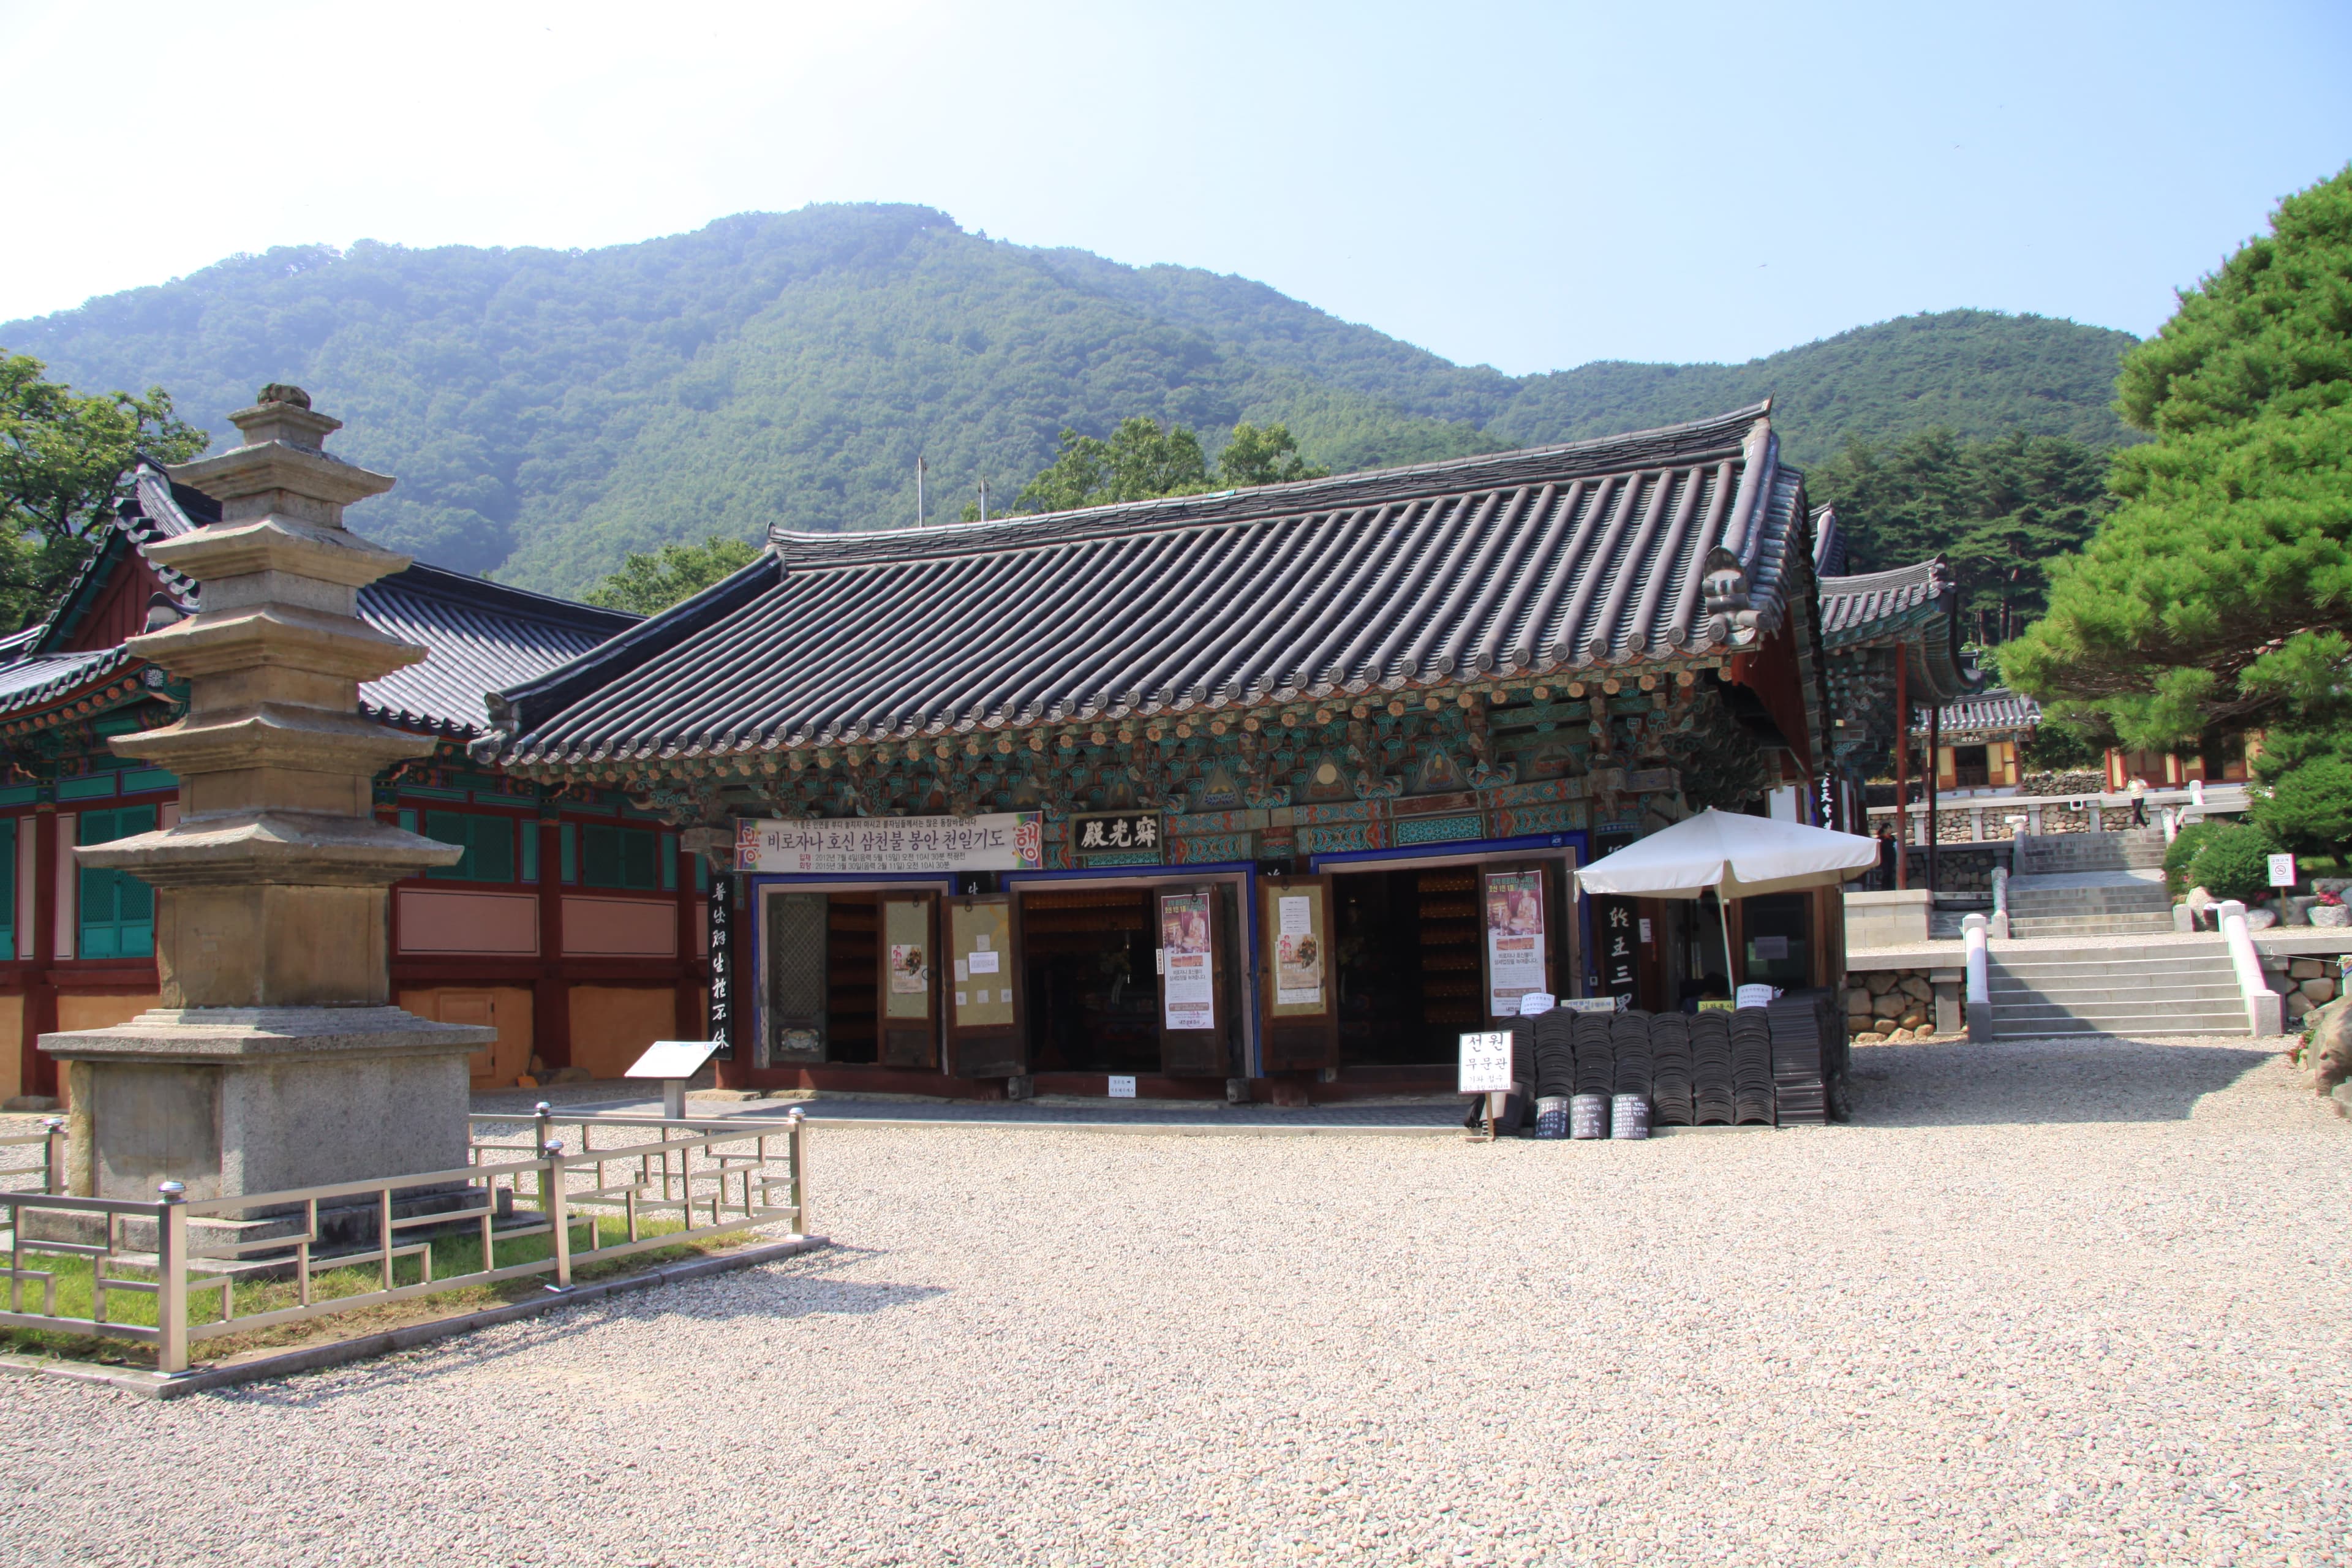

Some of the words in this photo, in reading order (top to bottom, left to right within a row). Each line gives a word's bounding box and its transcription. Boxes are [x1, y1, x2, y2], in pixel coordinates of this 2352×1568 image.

[845, 820, 862, 829] 놓치지
[883, 819, 924, 827] 불자님들께서는
[941, 818, 976, 826] 동참바랍니다
[736, 827, 760, 863] 봉
[768, 831, 823, 851] 비로자나
[827, 831, 854, 851] 호신
[860, 831, 904, 851] 삼천불
[908, 830, 938, 851] 봉안
[942, 828, 1005, 850] 천일기도
[1015, 823, 1039, 861] 행
[1466, 1057, 1507, 1071] 무문관
